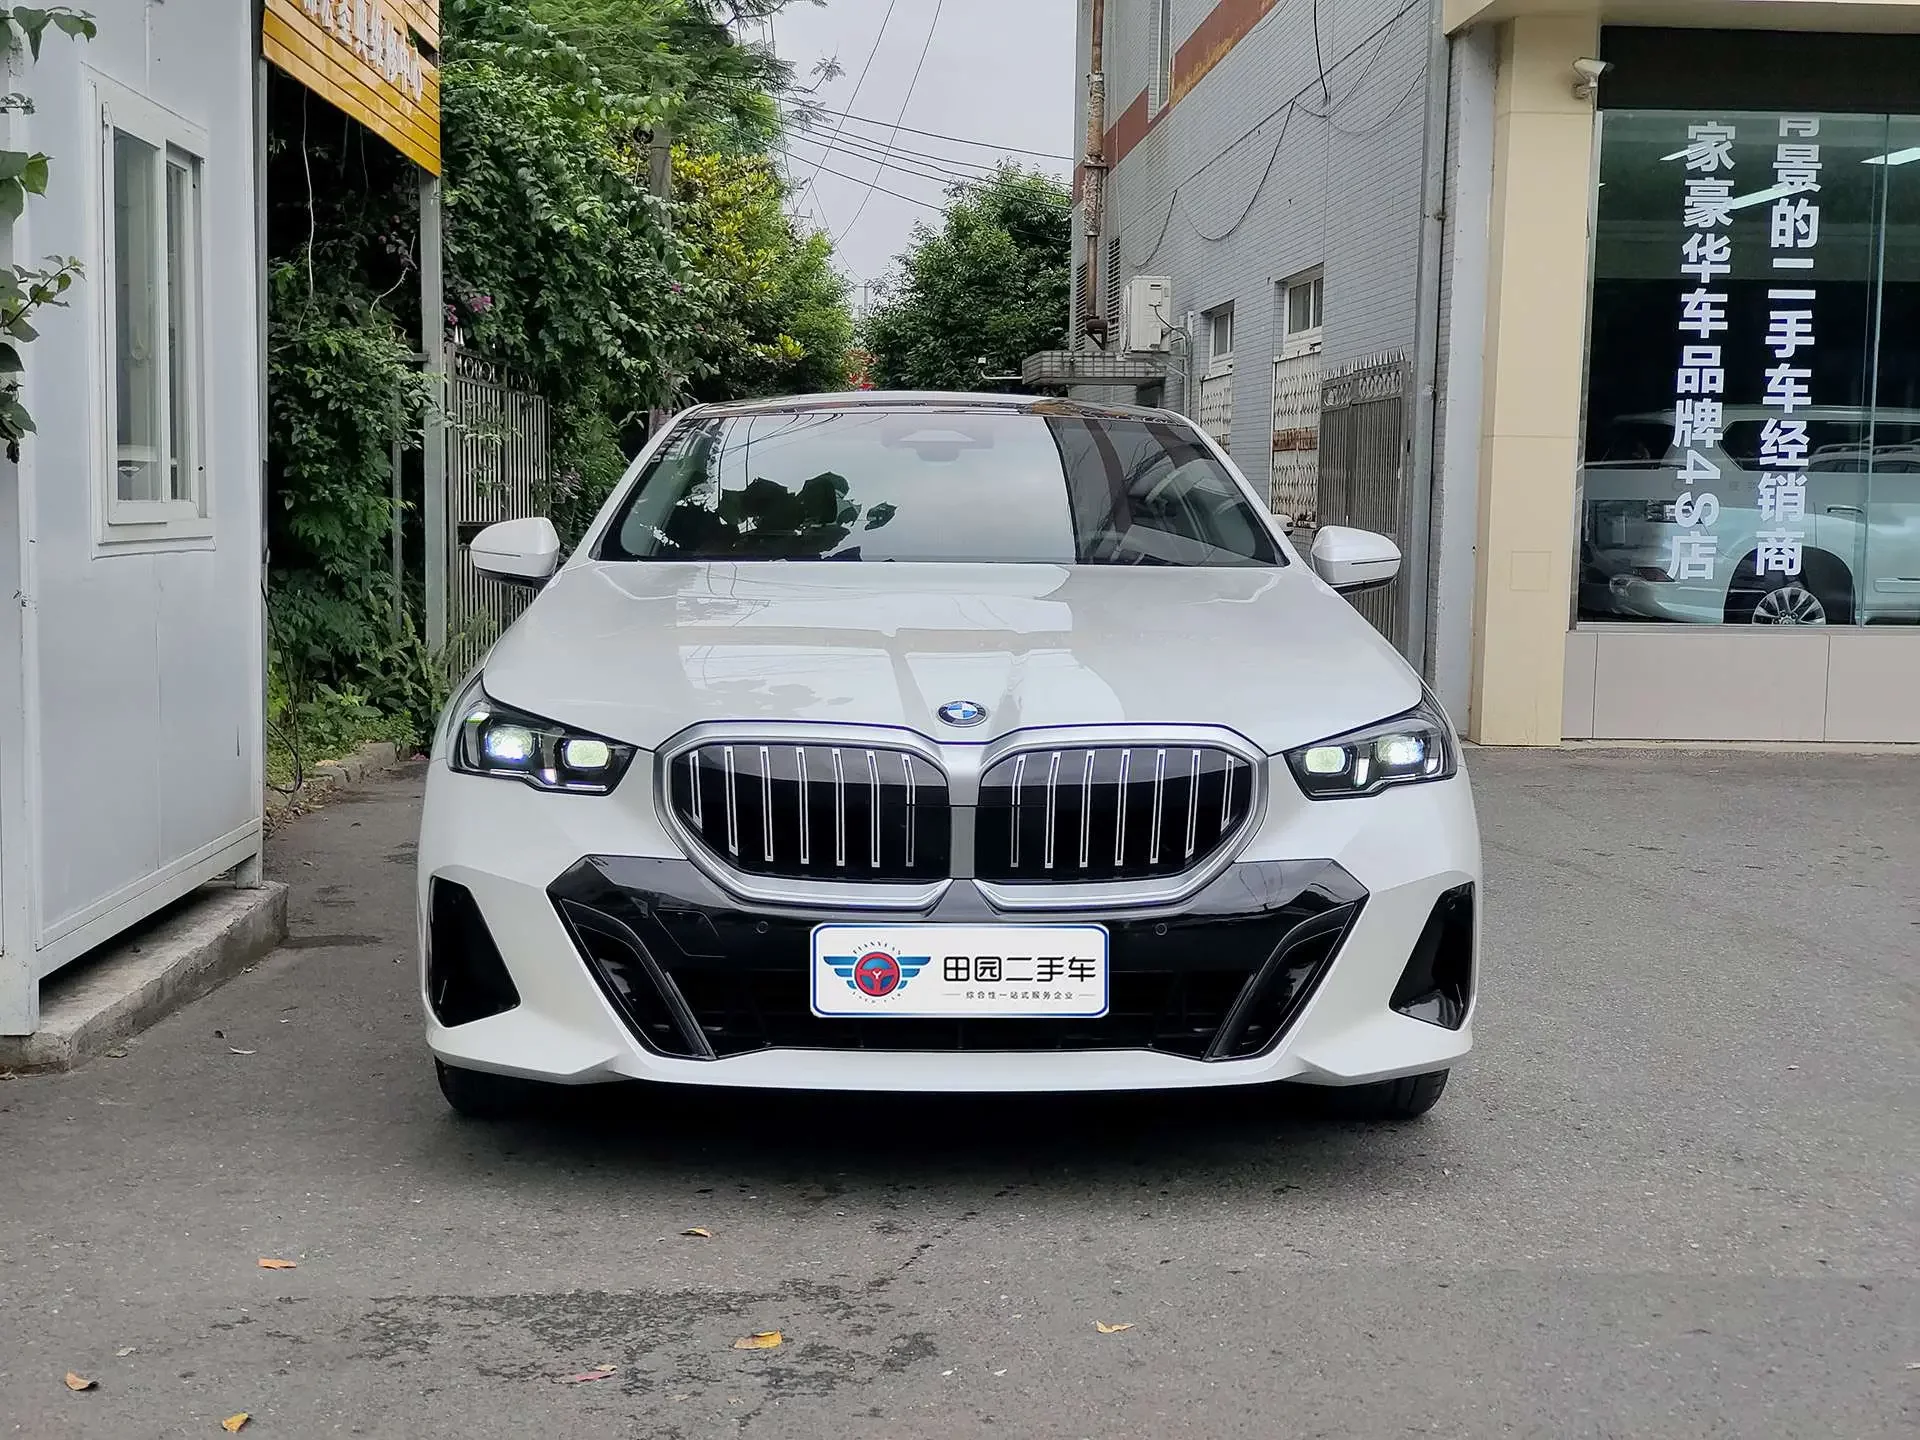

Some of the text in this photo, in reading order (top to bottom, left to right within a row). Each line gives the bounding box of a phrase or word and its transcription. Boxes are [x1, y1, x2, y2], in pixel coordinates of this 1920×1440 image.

[1666, 121, 1736, 580] 家豪华车品牌4S店
[943, 956, 1097, 982] 田园二手车
